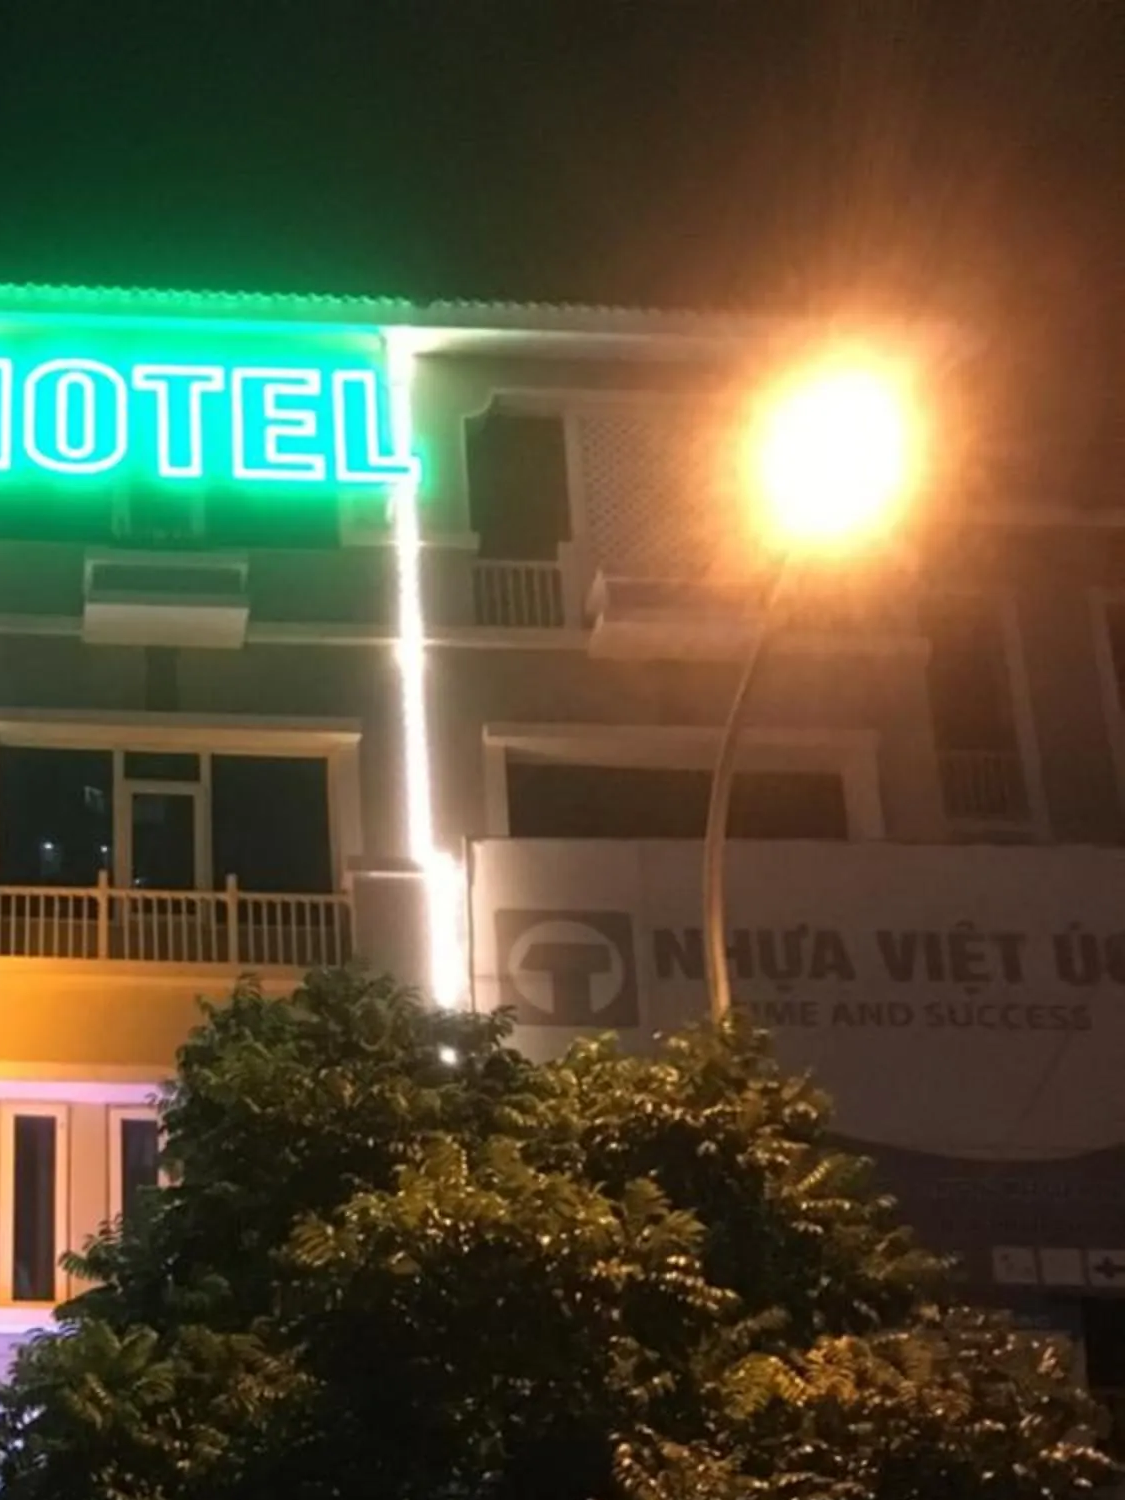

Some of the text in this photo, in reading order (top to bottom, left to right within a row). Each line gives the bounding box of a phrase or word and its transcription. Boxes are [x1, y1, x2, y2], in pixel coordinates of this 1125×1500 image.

[876, 920, 1026, 996] VIỆT
[831, 1001, 913, 1028] AND
[926, 1000, 1093, 1031] SUCCESS
